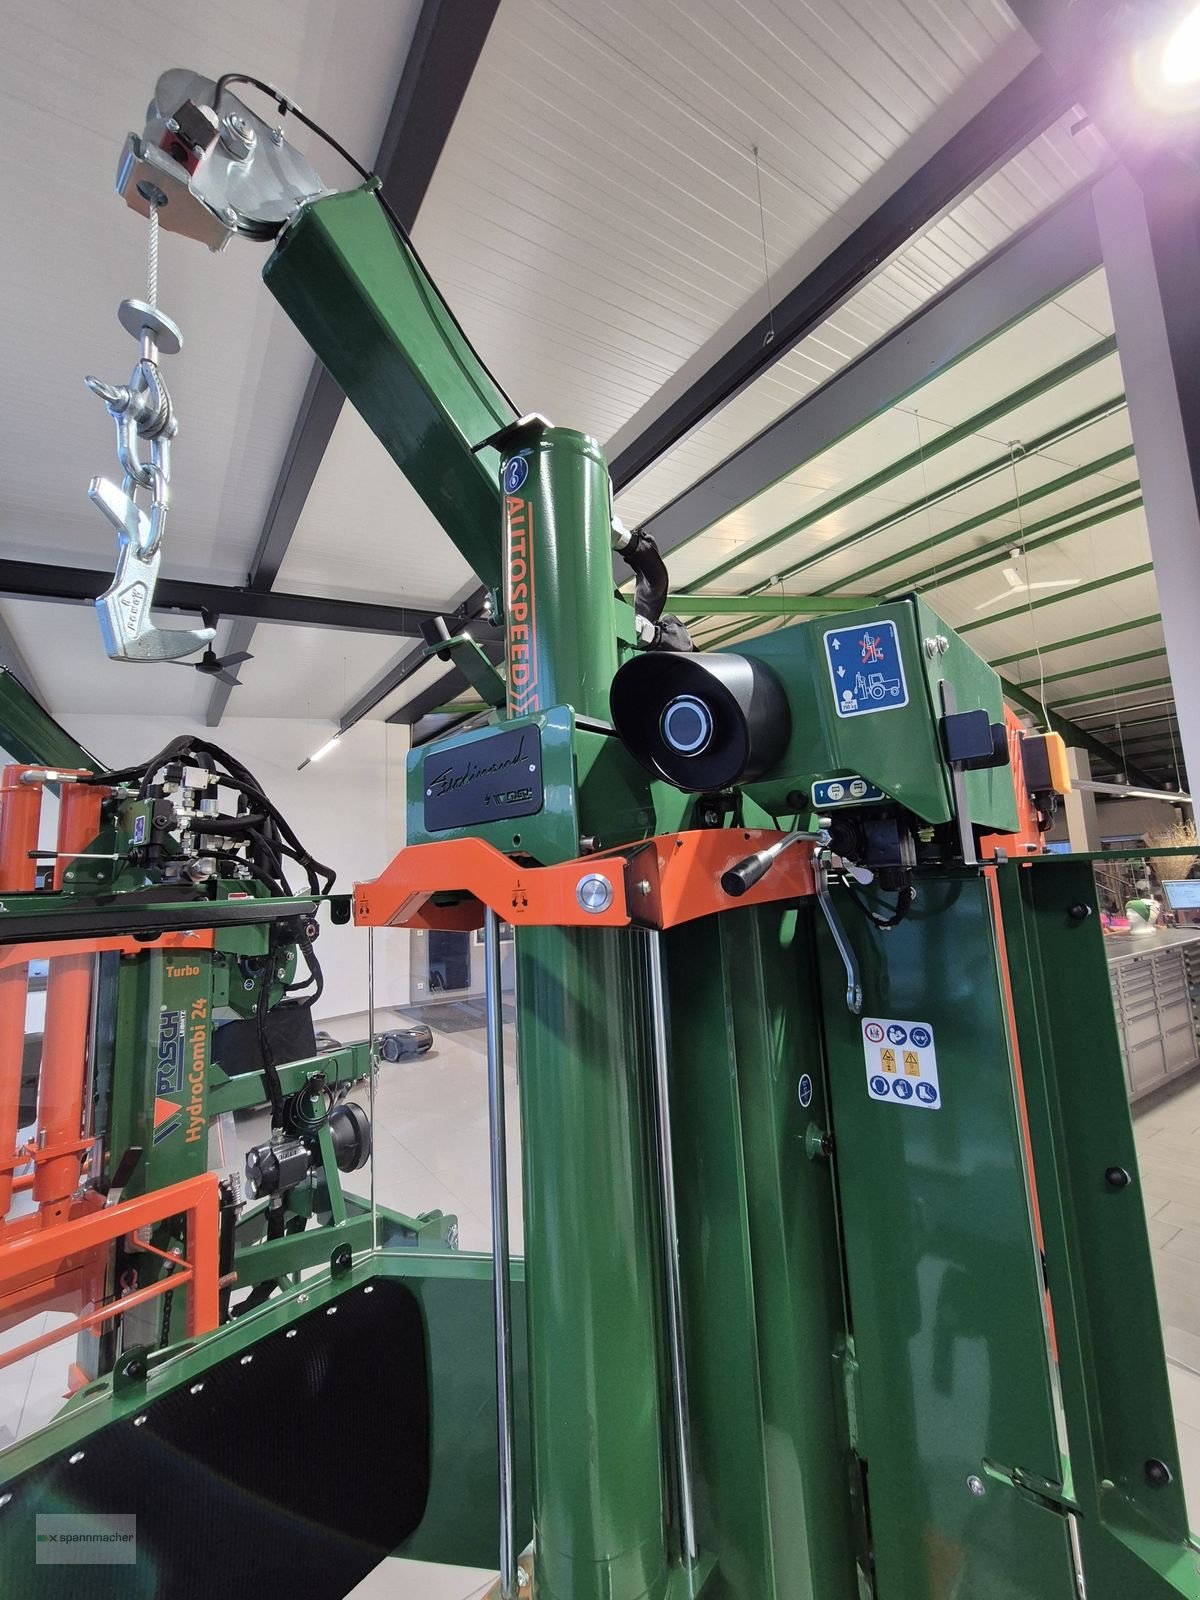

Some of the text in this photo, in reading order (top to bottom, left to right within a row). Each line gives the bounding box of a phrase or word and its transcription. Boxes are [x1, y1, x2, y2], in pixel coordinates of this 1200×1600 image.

[506, 495, 530, 687] AUTOSPEED
[166, 965, 200, 978] Turbo
[156, 1010, 180, 1096] POSCH
[185, 998, 207, 1143] HydroCombi 24
